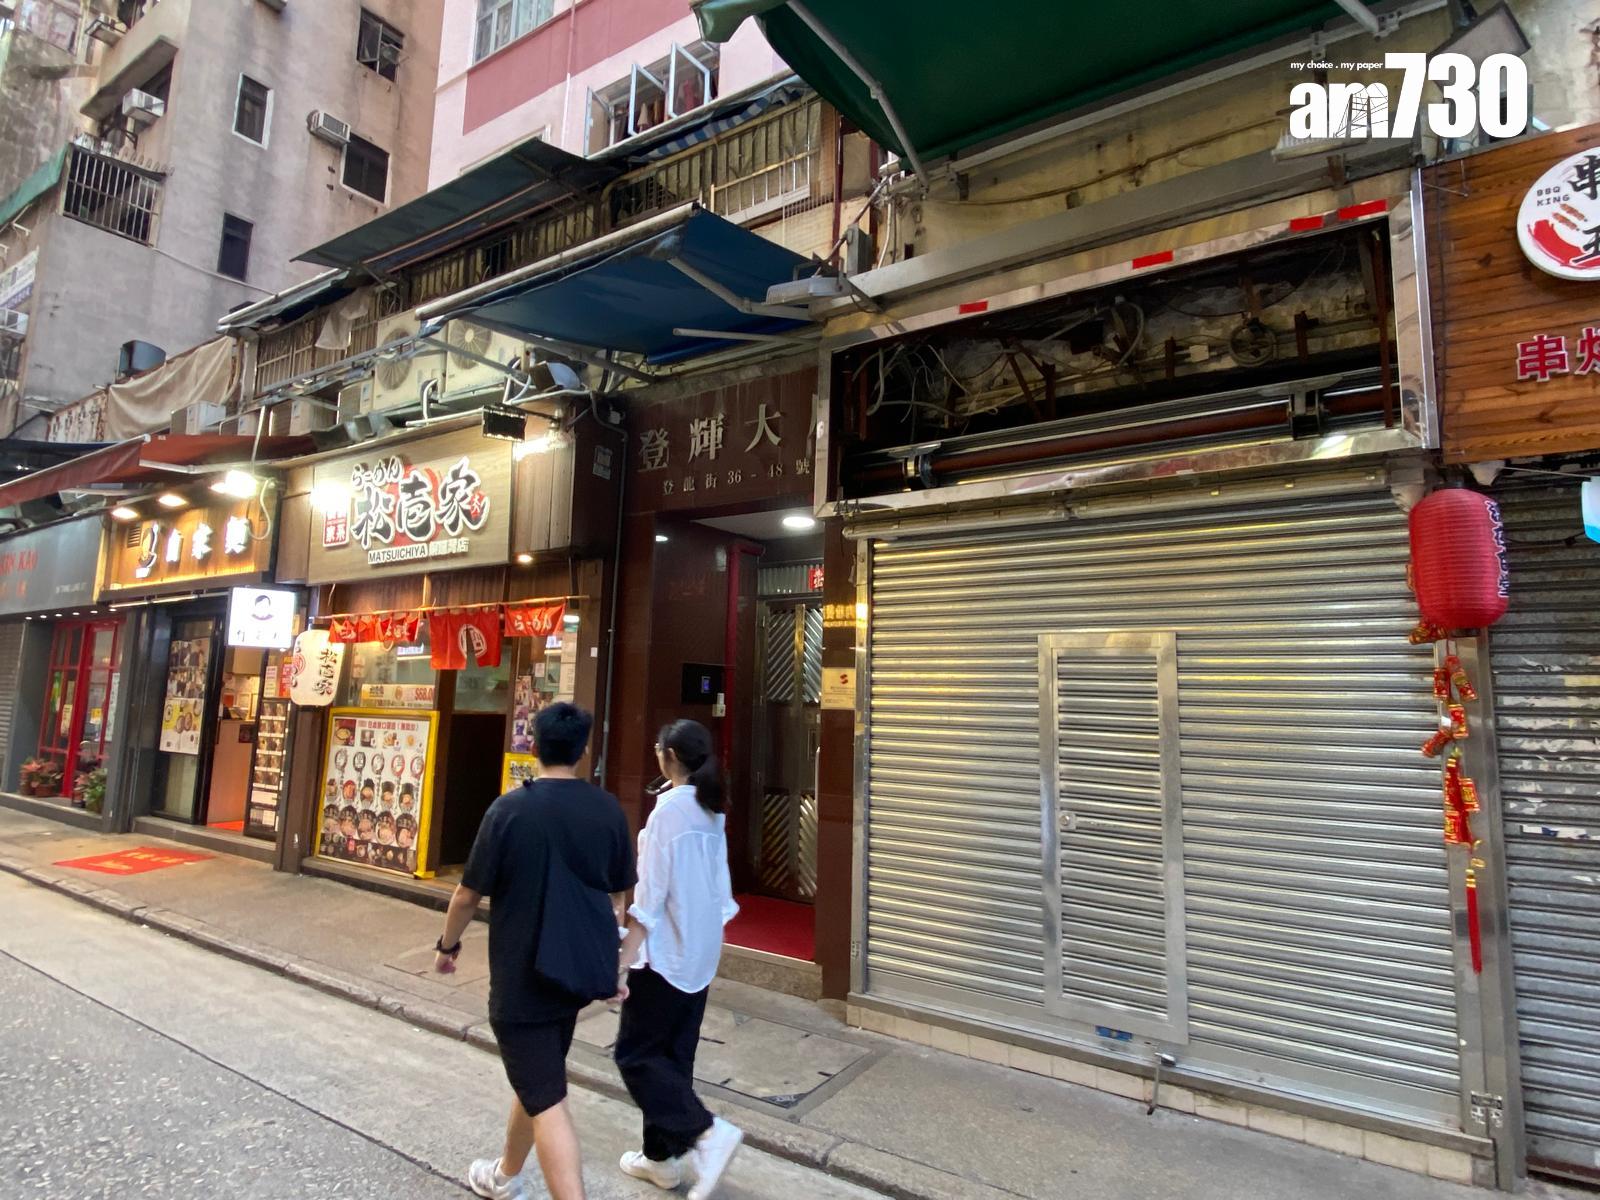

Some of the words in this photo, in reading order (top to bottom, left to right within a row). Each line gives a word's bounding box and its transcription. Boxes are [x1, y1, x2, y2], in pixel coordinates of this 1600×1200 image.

[1536, 186, 1561, 197] BBQ
[1536, 195, 1571, 207] KING
[638, 393, 819, 473] 登輝大
[368, 545, 426, 563] MATSUICHIYA
